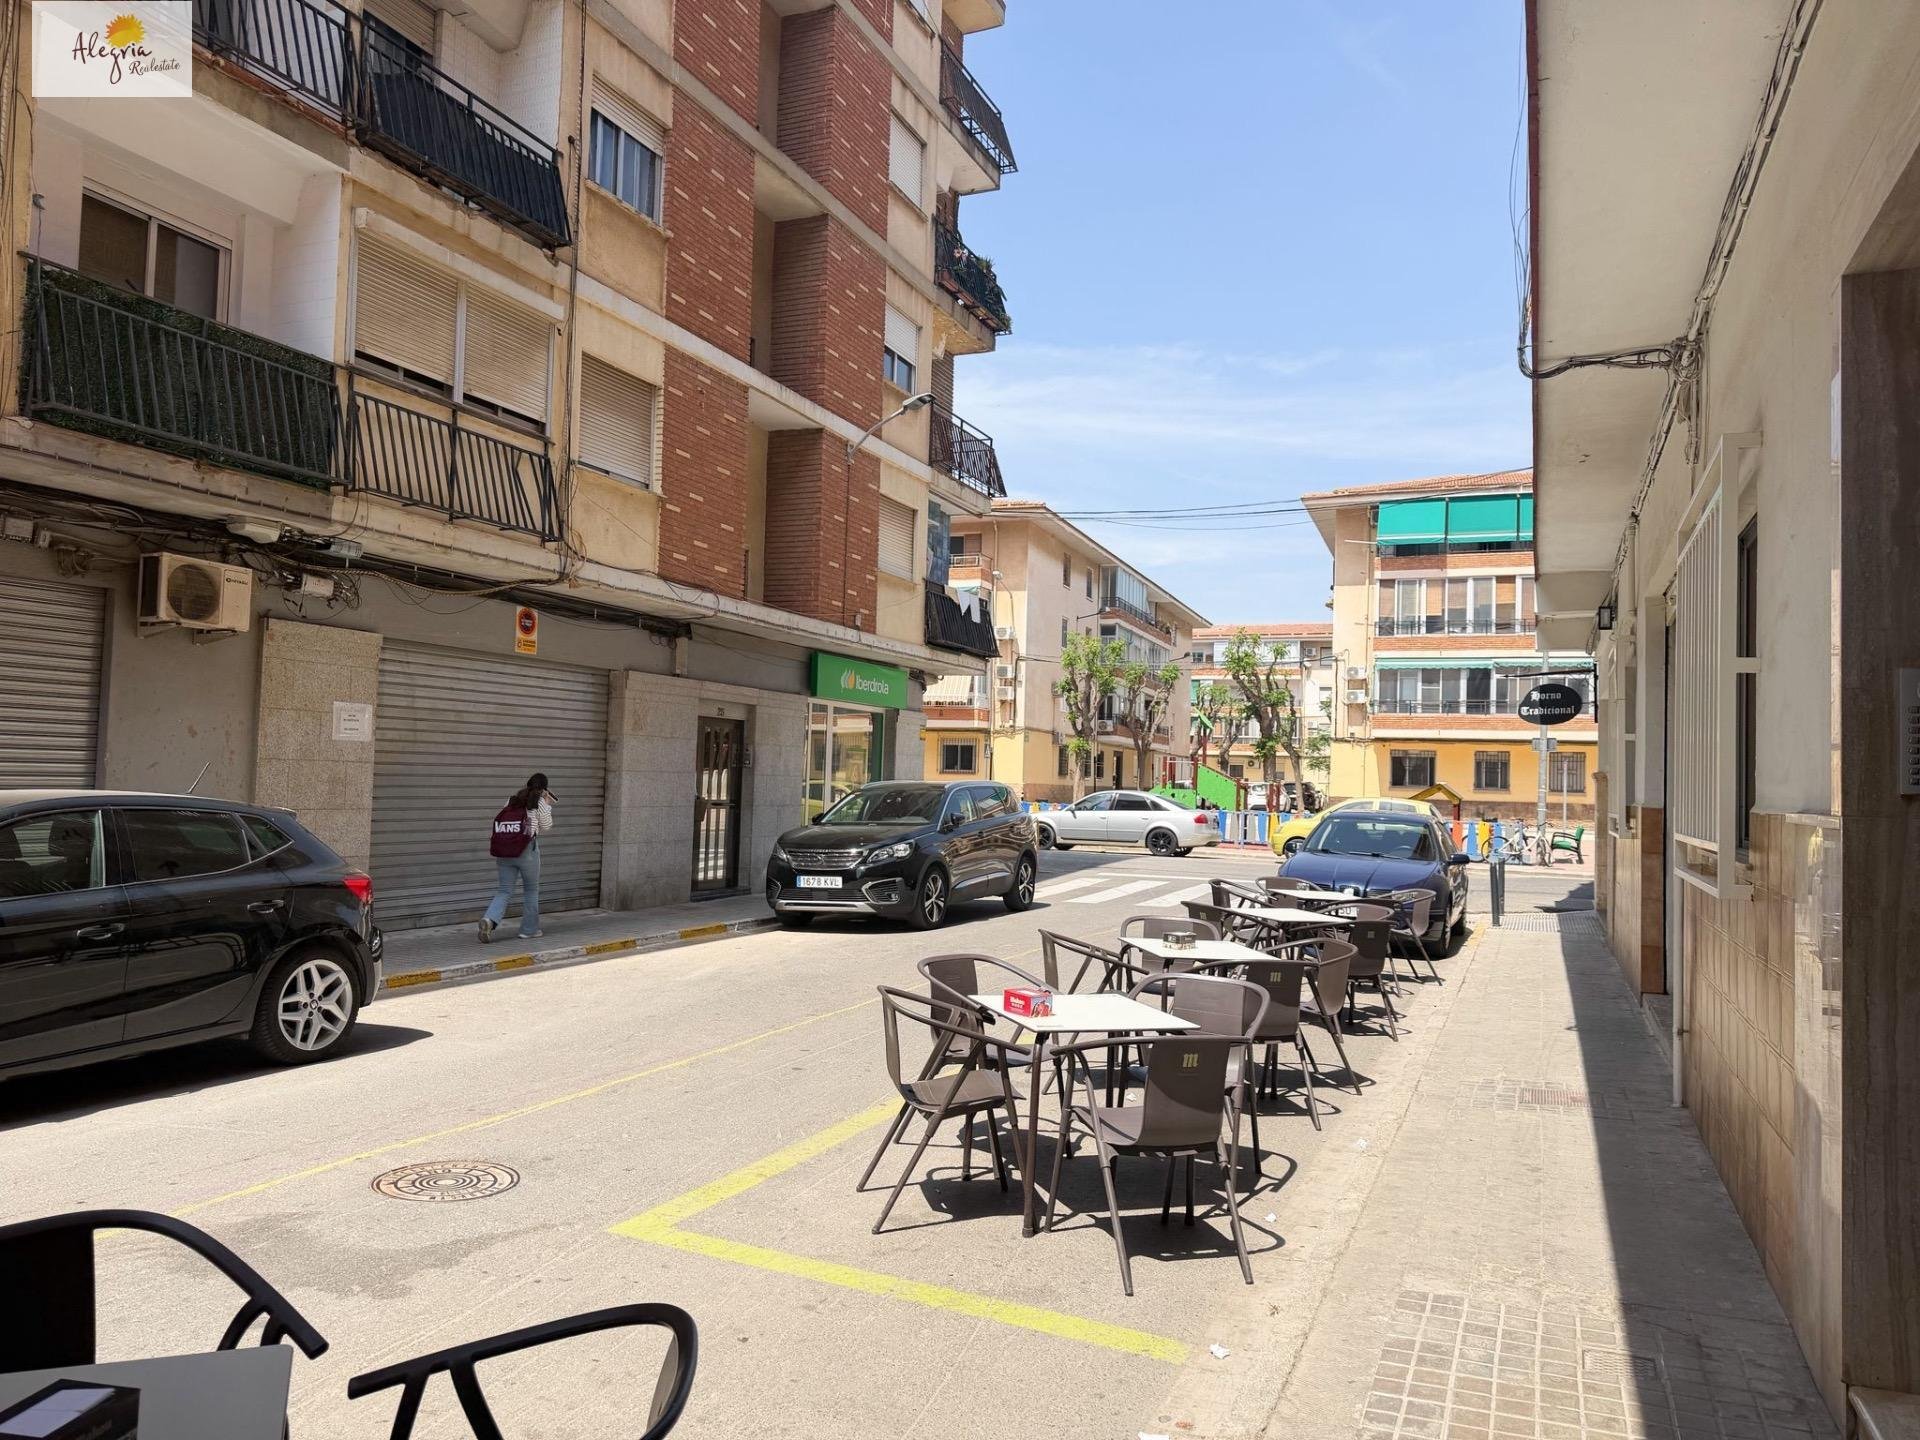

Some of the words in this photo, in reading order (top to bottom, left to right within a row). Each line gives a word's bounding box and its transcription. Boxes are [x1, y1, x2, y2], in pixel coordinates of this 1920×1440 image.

[855, 674, 889, 695] Iberdrola
[1530, 690, 1562, 701] Horno
[1520, 705, 1576, 716] Tradicional
[494, 821, 521, 833] VANS
[802, 877, 821, 887] 1678
